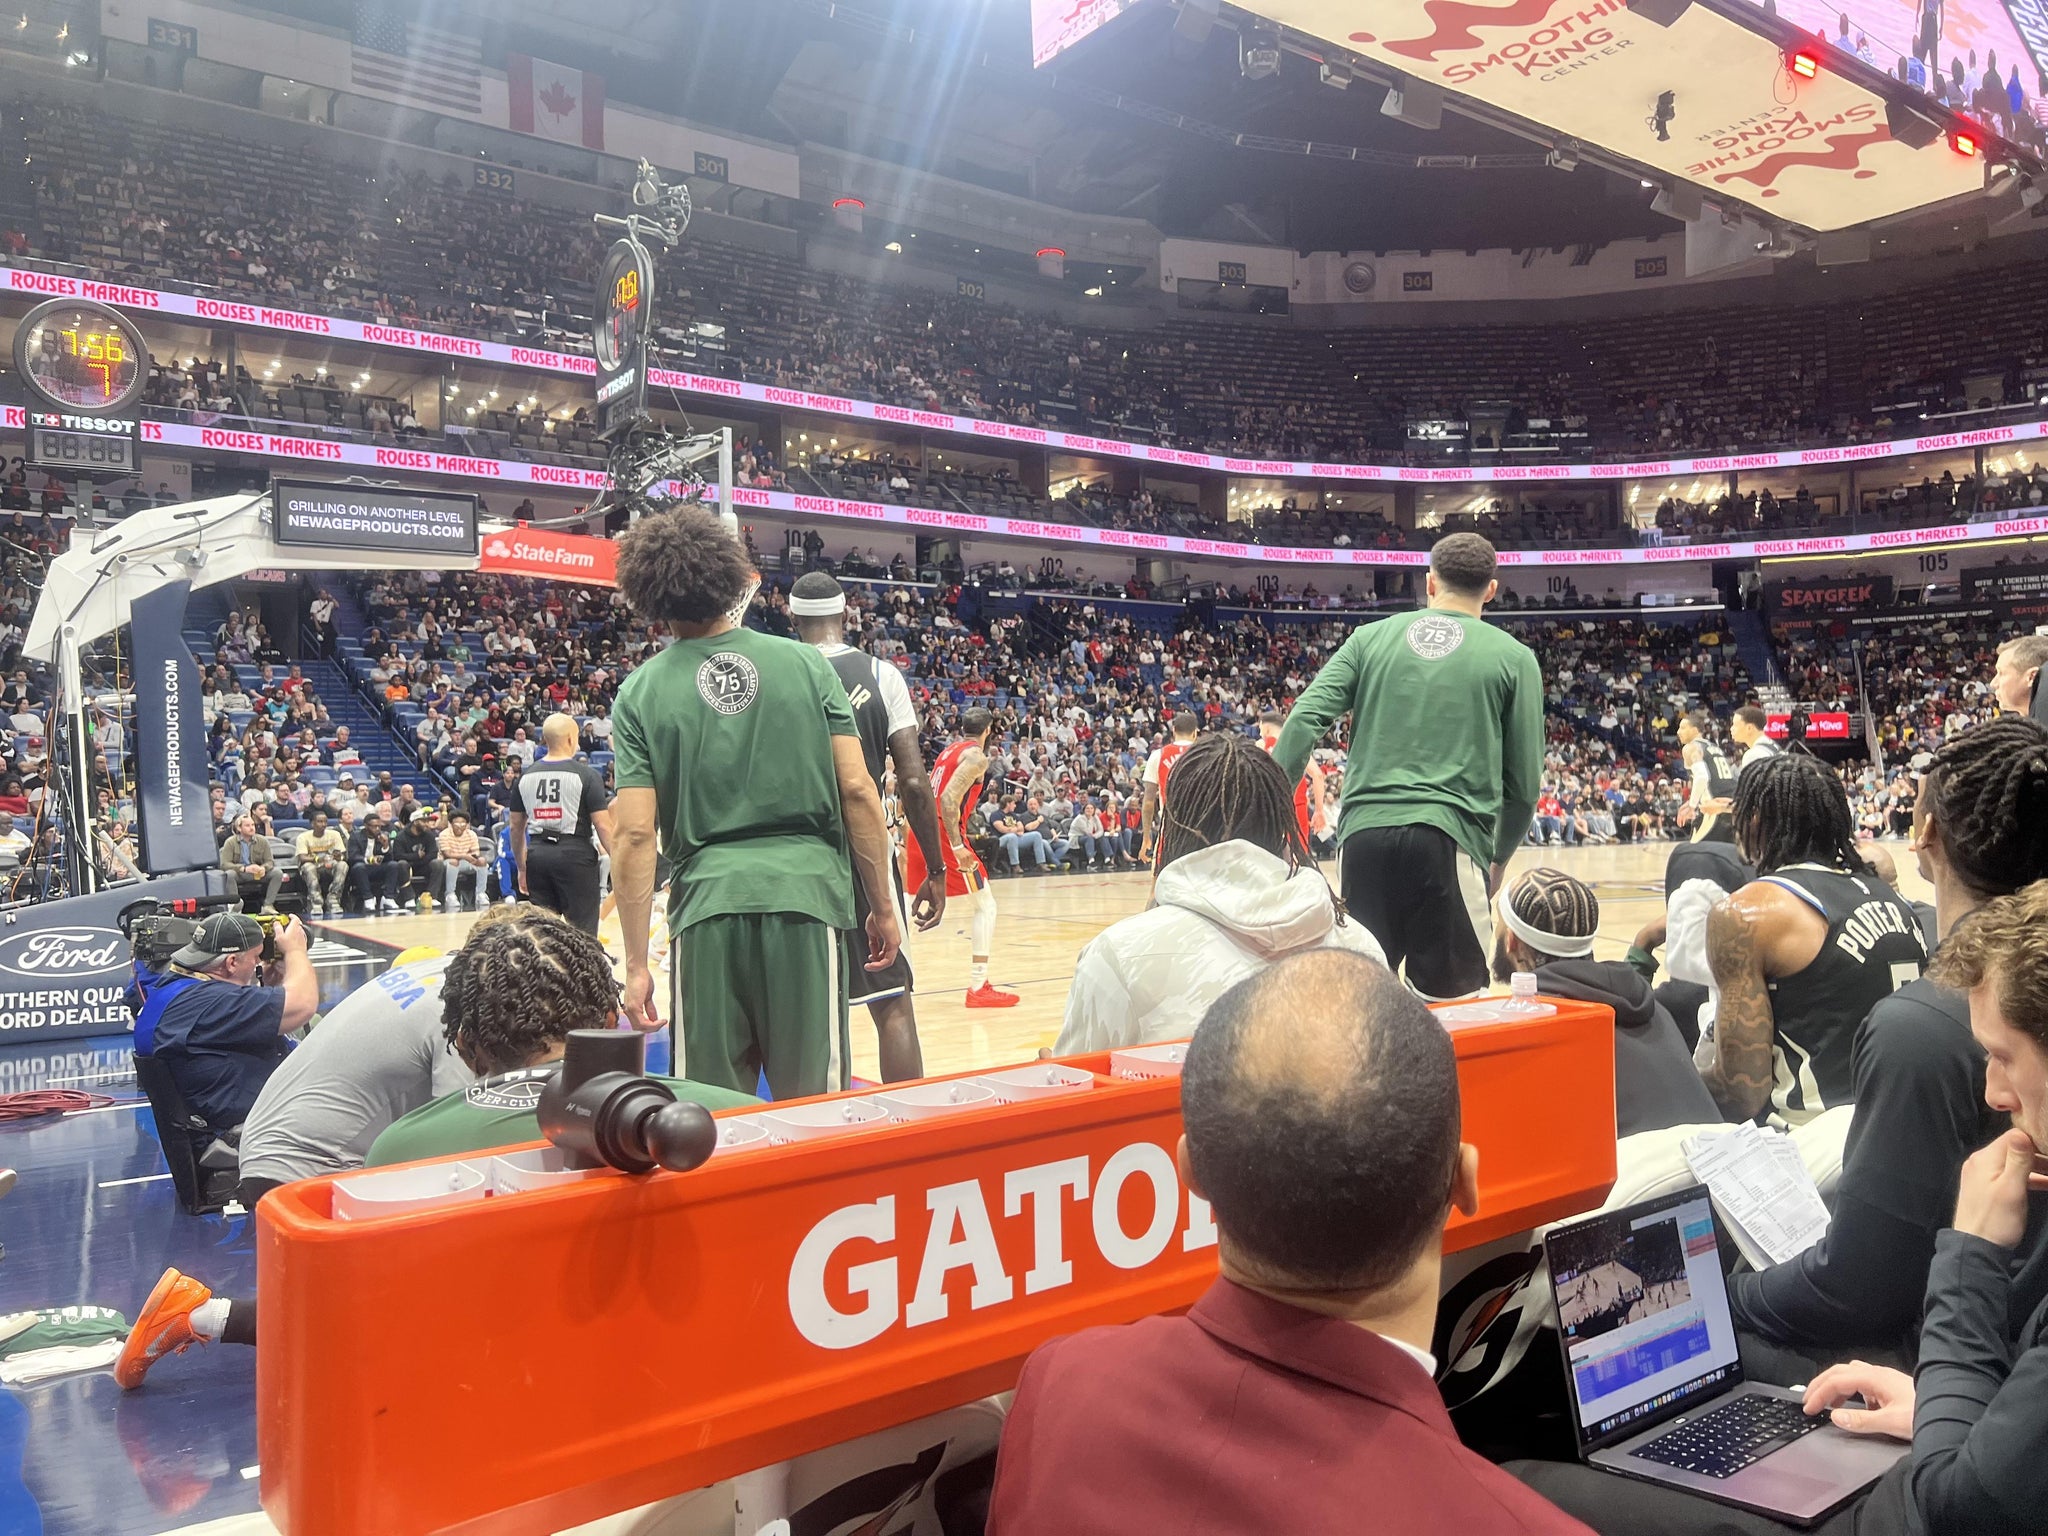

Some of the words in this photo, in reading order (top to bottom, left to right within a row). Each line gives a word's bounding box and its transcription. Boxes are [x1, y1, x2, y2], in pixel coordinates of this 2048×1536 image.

[153, 24, 192, 49] 331
[1540, 39, 1635, 82] CENTER
[1695, 106, 1788, 142] CENTER
[1684, 103, 1876, 176] SMOOTHIE
[699, 160, 725, 177] 301
[475, 167, 513, 191] 332
[1219, 264, 1246, 280] 303
[1635, 260, 1667, 276] 305
[11, 271, 77, 295] ROUSES
[82, 282, 159, 308] MARKETS
[1403, 273, 1433, 289] 304
[958, 283, 984, 300] 302
[196, 299, 256, 322] ROUSES
[261, 309, 330, 333] MARKETS
[363, 325, 416, 346] ROUSES
[420, 334, 482, 356] MARKETS
[511, 348, 559, 367] ROUSES
[87, 362, 110, 397] 7
[607, 367, 635, 398] TISSOT
[691, 376, 741, 395] MARKETS
[765, 388, 804, 405] ROUSES
[807, 395, 853, 413] MARKETS
[61, 414, 135, 434] TISSOT
[874, 405, 910, 421] ROUSES
[912, 412, 954, 428] MARKETS
[974, 421, 1006, 436] ROUSES
[1008, 427, 1046, 442] MARKETS
[1916, 435, 1958, 450] ROUSES
[1961, 427, 2014, 444] MARKETS
[201, 429, 264, 451] ROUSES
[269, 437, 342, 459] MARKETS
[1064, 435, 1094, 449] ROUSES
[1096, 440, 1131, 454] MARKETS
[1801, 449, 1840, 462] ROUSES
[1843, 443, 1892, 458] MARKETS
[376, 449, 432, 469] ROUSES
[436, 456, 500, 476] MARKETS
[1148, 448, 1176, 461] ROUSES
[1177, 452, 1210, 466] MARKETS
[1225, 459, 1253, 471] ROUSES
[1255, 462, 1293, 473] MARKETS
[1692, 458, 1729, 471] ROUSES
[1732, 454, 1778, 467] MARKETS
[172, 464, 188, 476] 123
[530, 465, 581, 485] ROUSES
[1312, 464, 1343, 476] ROUSES
[1344, 466, 1381, 477] MARKETS
[1399, 469, 1429, 480] ROUSES
[1432, 468, 1472, 480] MARKETS
[1493, 468, 1527, 478] ROUSES
[1529, 466, 1570, 477] MARKETS
[1590, 465, 1624, 476] ROUSES
[1627, 462, 1670, 475] MARKETS
[288, 499, 346, 515] GRILLING
[349, 504, 368, 516] ON
[370, 506, 426, 521] ANOTHER
[429, 511, 464, 524] LEVEL
[794, 496, 835, 512] ROUSES
[837, 501, 884, 518] MARKETS
[288, 514, 464, 538] NEWAGEPRODUCTS.COM
[906, 509, 943, 525] ROUSES
[945, 514, 988, 529] MARKETS
[1994, 519, 2040, 534] ROUSES
[1007, 521, 1040, 535] ROUSES
[1043, 525, 1082, 539] MARKETS
[1099, 531, 1130, 544] ROUSES
[1132, 534, 1168, 548] MARKETS
[1870, 532, 1912, 546] ROUSES
[1915, 526, 1968, 541] MARKETS
[1184, 539, 1213, 553] ROUSES
[1214, 543, 1248, 556] MARKETS
[1263, 548, 1293, 560] ROUSES
[1295, 549, 1334, 560] MARKETS
[1644, 548, 1682, 560] ROUSES
[1684, 545, 1731, 557] MARKETS
[1754, 541, 1794, 554] ROUSES
[1796, 538, 1845, 551] MARKETS
[1352, 551, 1384, 562] ROUSES
[1386, 552, 1424, 563] MARKETS
[1542, 552, 1578, 563] ROUSES
[1580, 550, 1622, 562] MARKETS
[1918, 553, 1949, 573] 105
[1256, 575, 1279, 592] 103
[1546, 576, 1572, 593] 104
[1423, 628, 1446, 643] 75
[715, 672, 741, 695] 75
[700, 683, 720, 708] COOPER
[721, 697, 749, 712] CLIFTON
[164, 659, 184, 827] NEWAGEPRODUCTS.COM
[1713, 756, 1733, 780] 18
[536, 778, 561, 803] 43
[1836, 901, 1909, 964] PORTER
[18, 934, 119, 970] Ford
